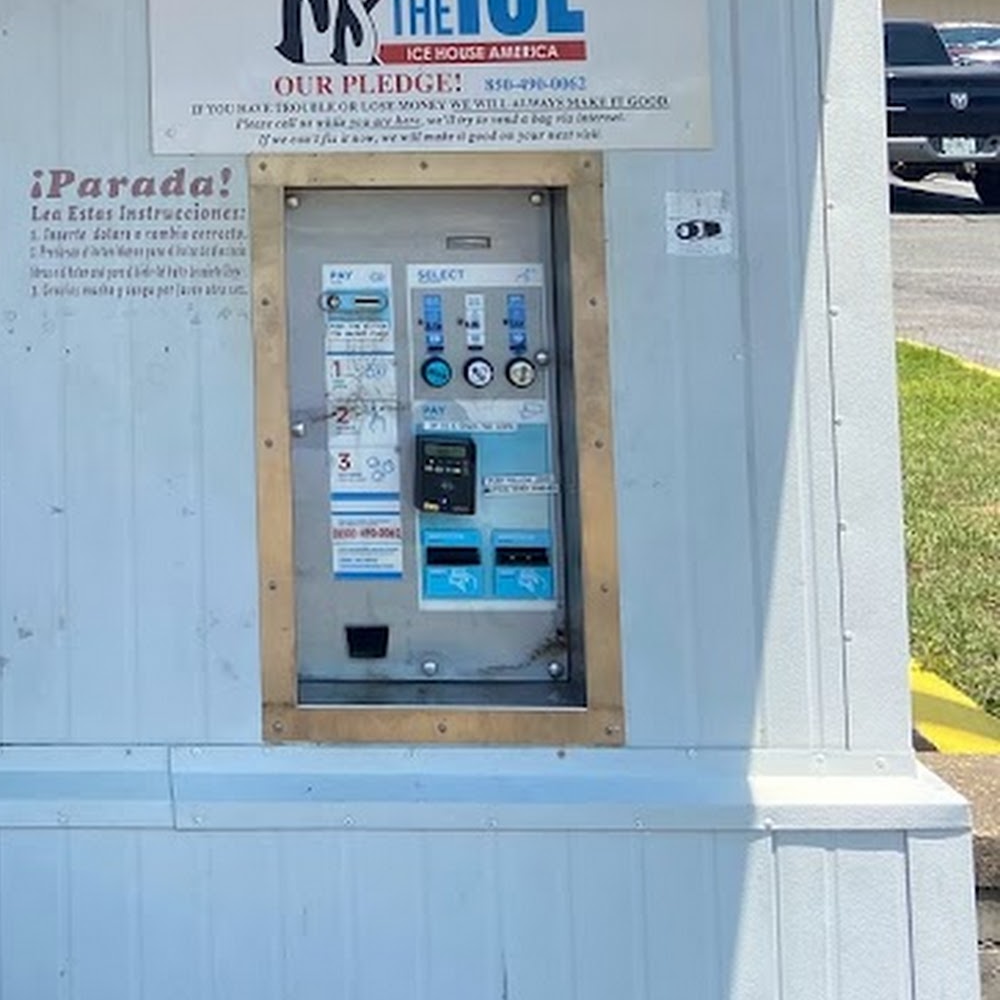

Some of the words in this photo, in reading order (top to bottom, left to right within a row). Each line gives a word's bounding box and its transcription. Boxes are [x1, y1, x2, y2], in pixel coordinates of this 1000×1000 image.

[406, 46, 431, 62] ICE
[434, 45, 485, 61] HOUSE
[489, 44, 559, 60] AMERICA
[274, 75, 333, 95] OUR
[342, 73, 463, 95] PLEDGE!
[30, 167, 233, 199] ¡Parada!
[31, 205, 62, 221] Lea
[417, 269, 464, 280] SELECT
[332, 360, 342, 378] 1
[336, 407, 349, 424] 2
[422, 405, 446, 415] PAY
[338, 453, 351, 470] 3
